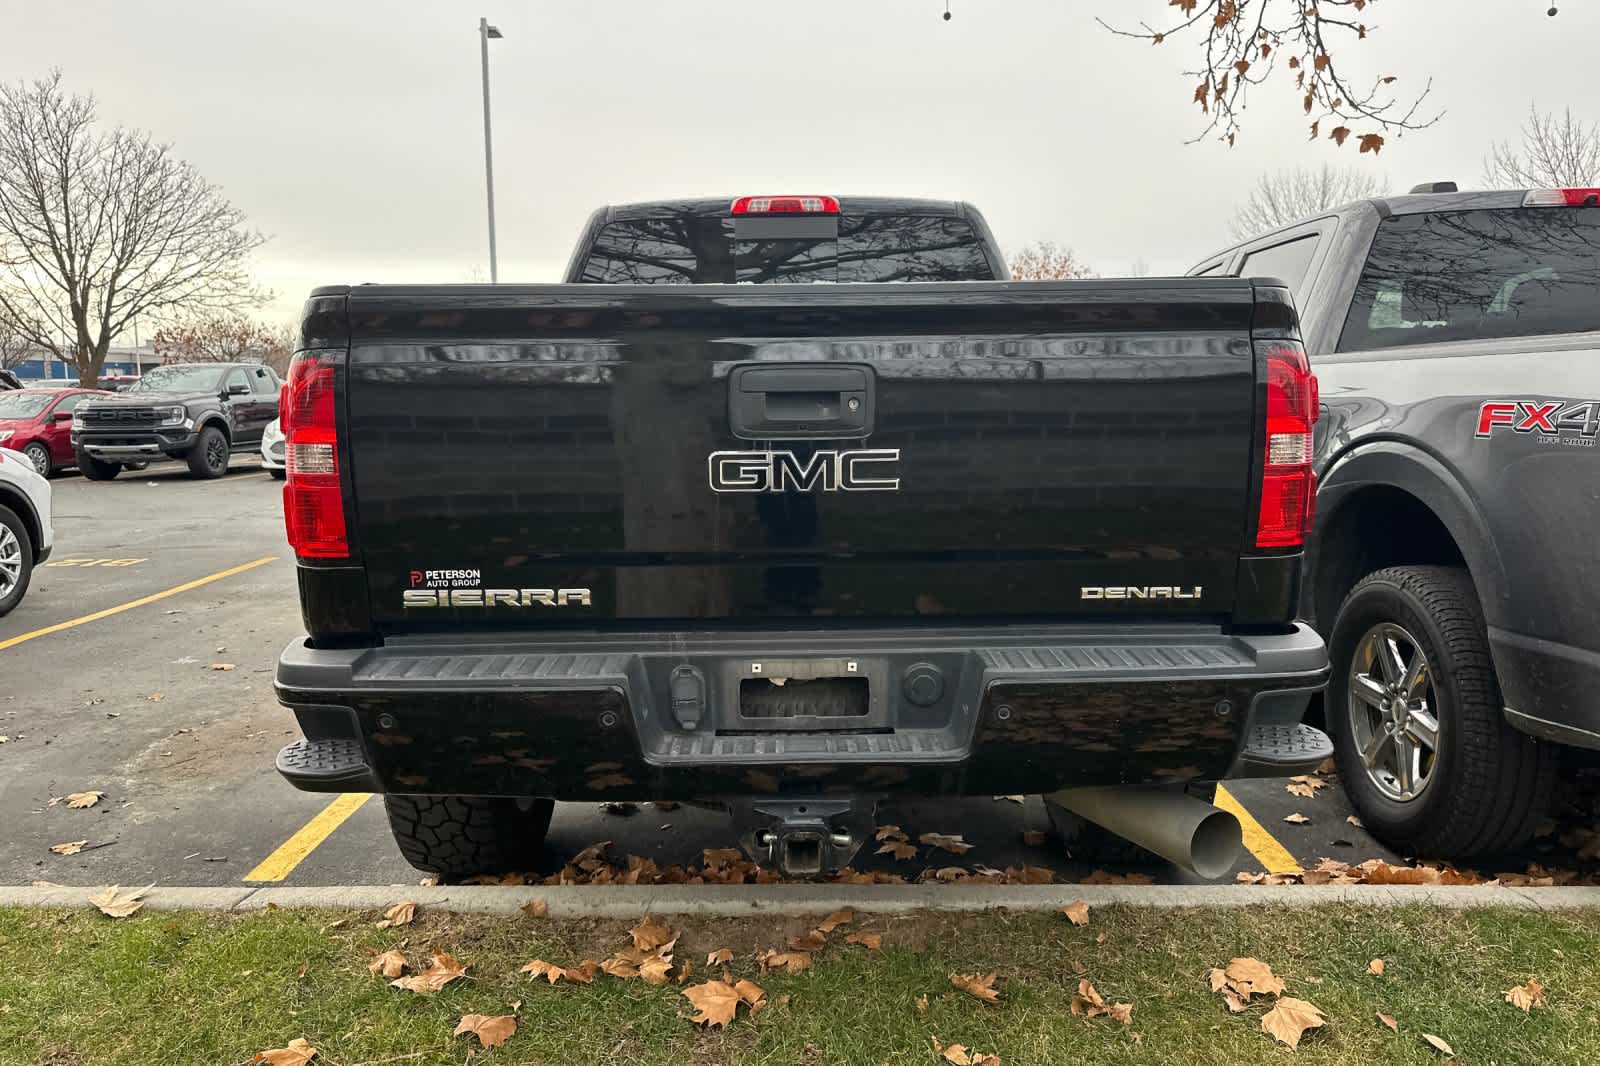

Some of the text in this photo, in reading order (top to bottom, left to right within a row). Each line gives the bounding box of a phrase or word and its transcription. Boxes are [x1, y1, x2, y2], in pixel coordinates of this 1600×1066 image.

[1474, 399, 1600, 439] FX4
[708, 448, 900, 492] GMC
[425, 569, 481, 580] PETERSON
[426, 579, 481, 588] AUTO GROUP
[402, 588, 592, 608] SIERRA
[1080, 586, 1203, 600] DENALI
